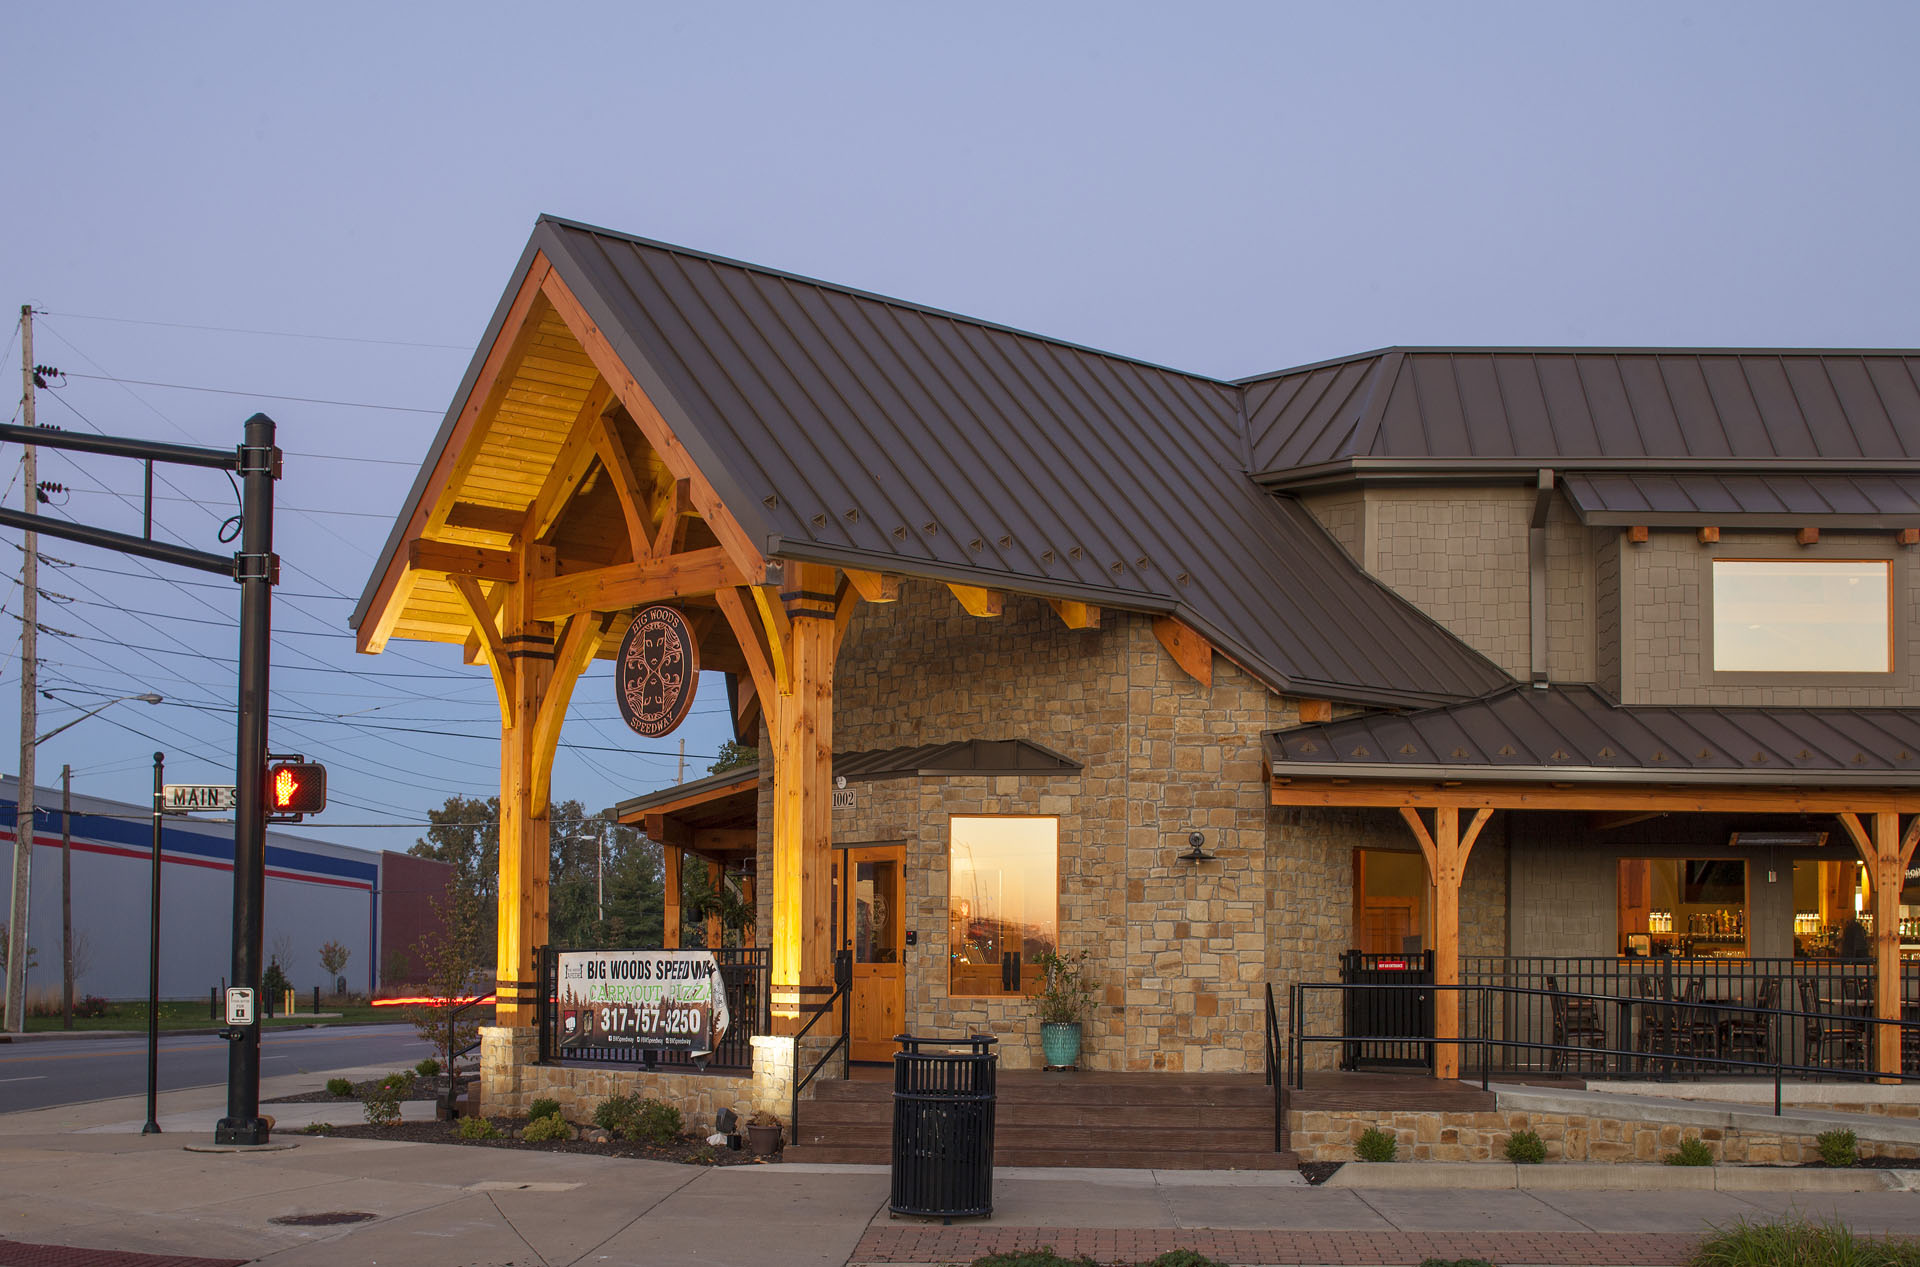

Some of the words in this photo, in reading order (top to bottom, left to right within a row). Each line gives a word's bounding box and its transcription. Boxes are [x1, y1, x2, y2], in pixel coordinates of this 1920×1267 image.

[631, 614, 648, 634] BIG
[650, 609, 680, 628] WOODS
[630, 711, 674, 734] SPEEDWAY
[173, 789, 218, 806] MAIN
[230, 789, 237, 806] S
[833, 791, 854, 807] 1002
[587, 960, 606, 980] BIG
[611, 960, 652, 980] WOODS
[589, 984, 663, 1002] CARRYOUT
[601, 1008, 701, 1034] 317-757-3250
